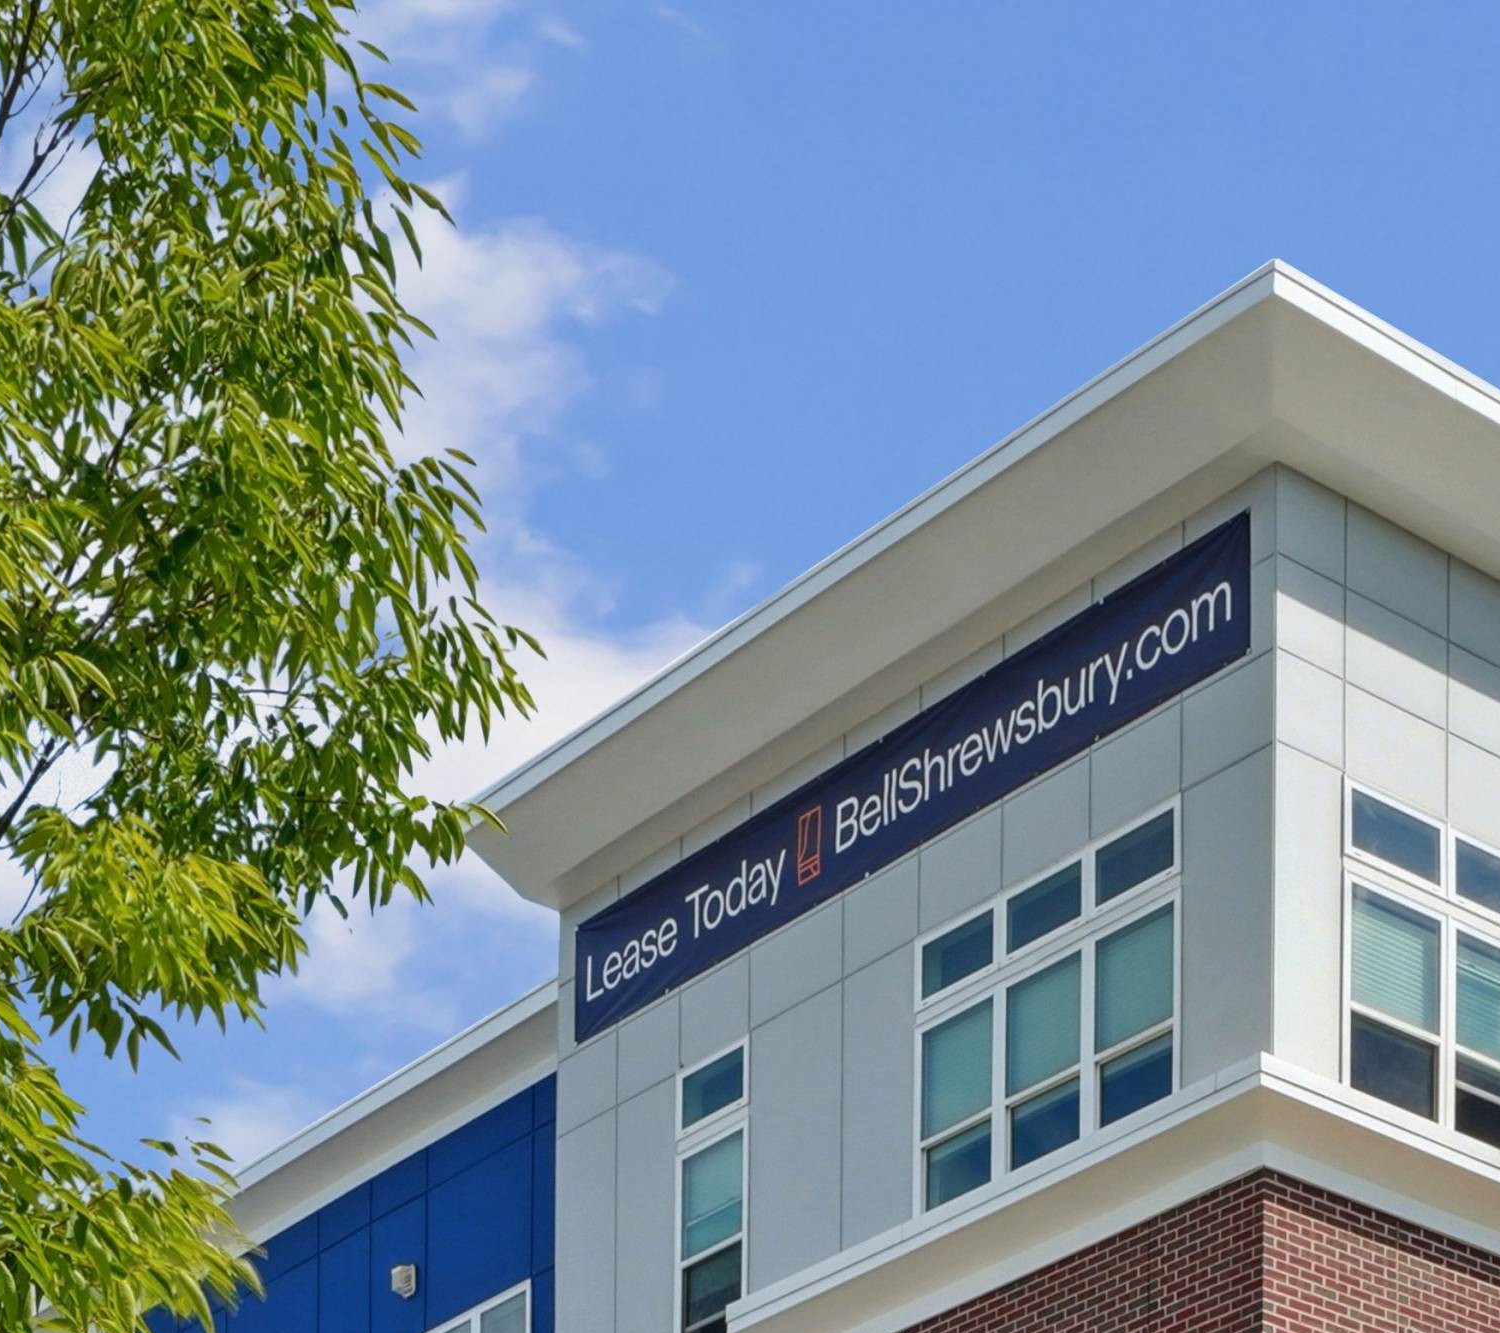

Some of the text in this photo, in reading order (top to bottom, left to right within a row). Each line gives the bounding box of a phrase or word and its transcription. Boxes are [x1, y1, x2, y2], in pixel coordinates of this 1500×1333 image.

[586, 580, 1232, 1002] Lease Today BellShrewsbury.com
